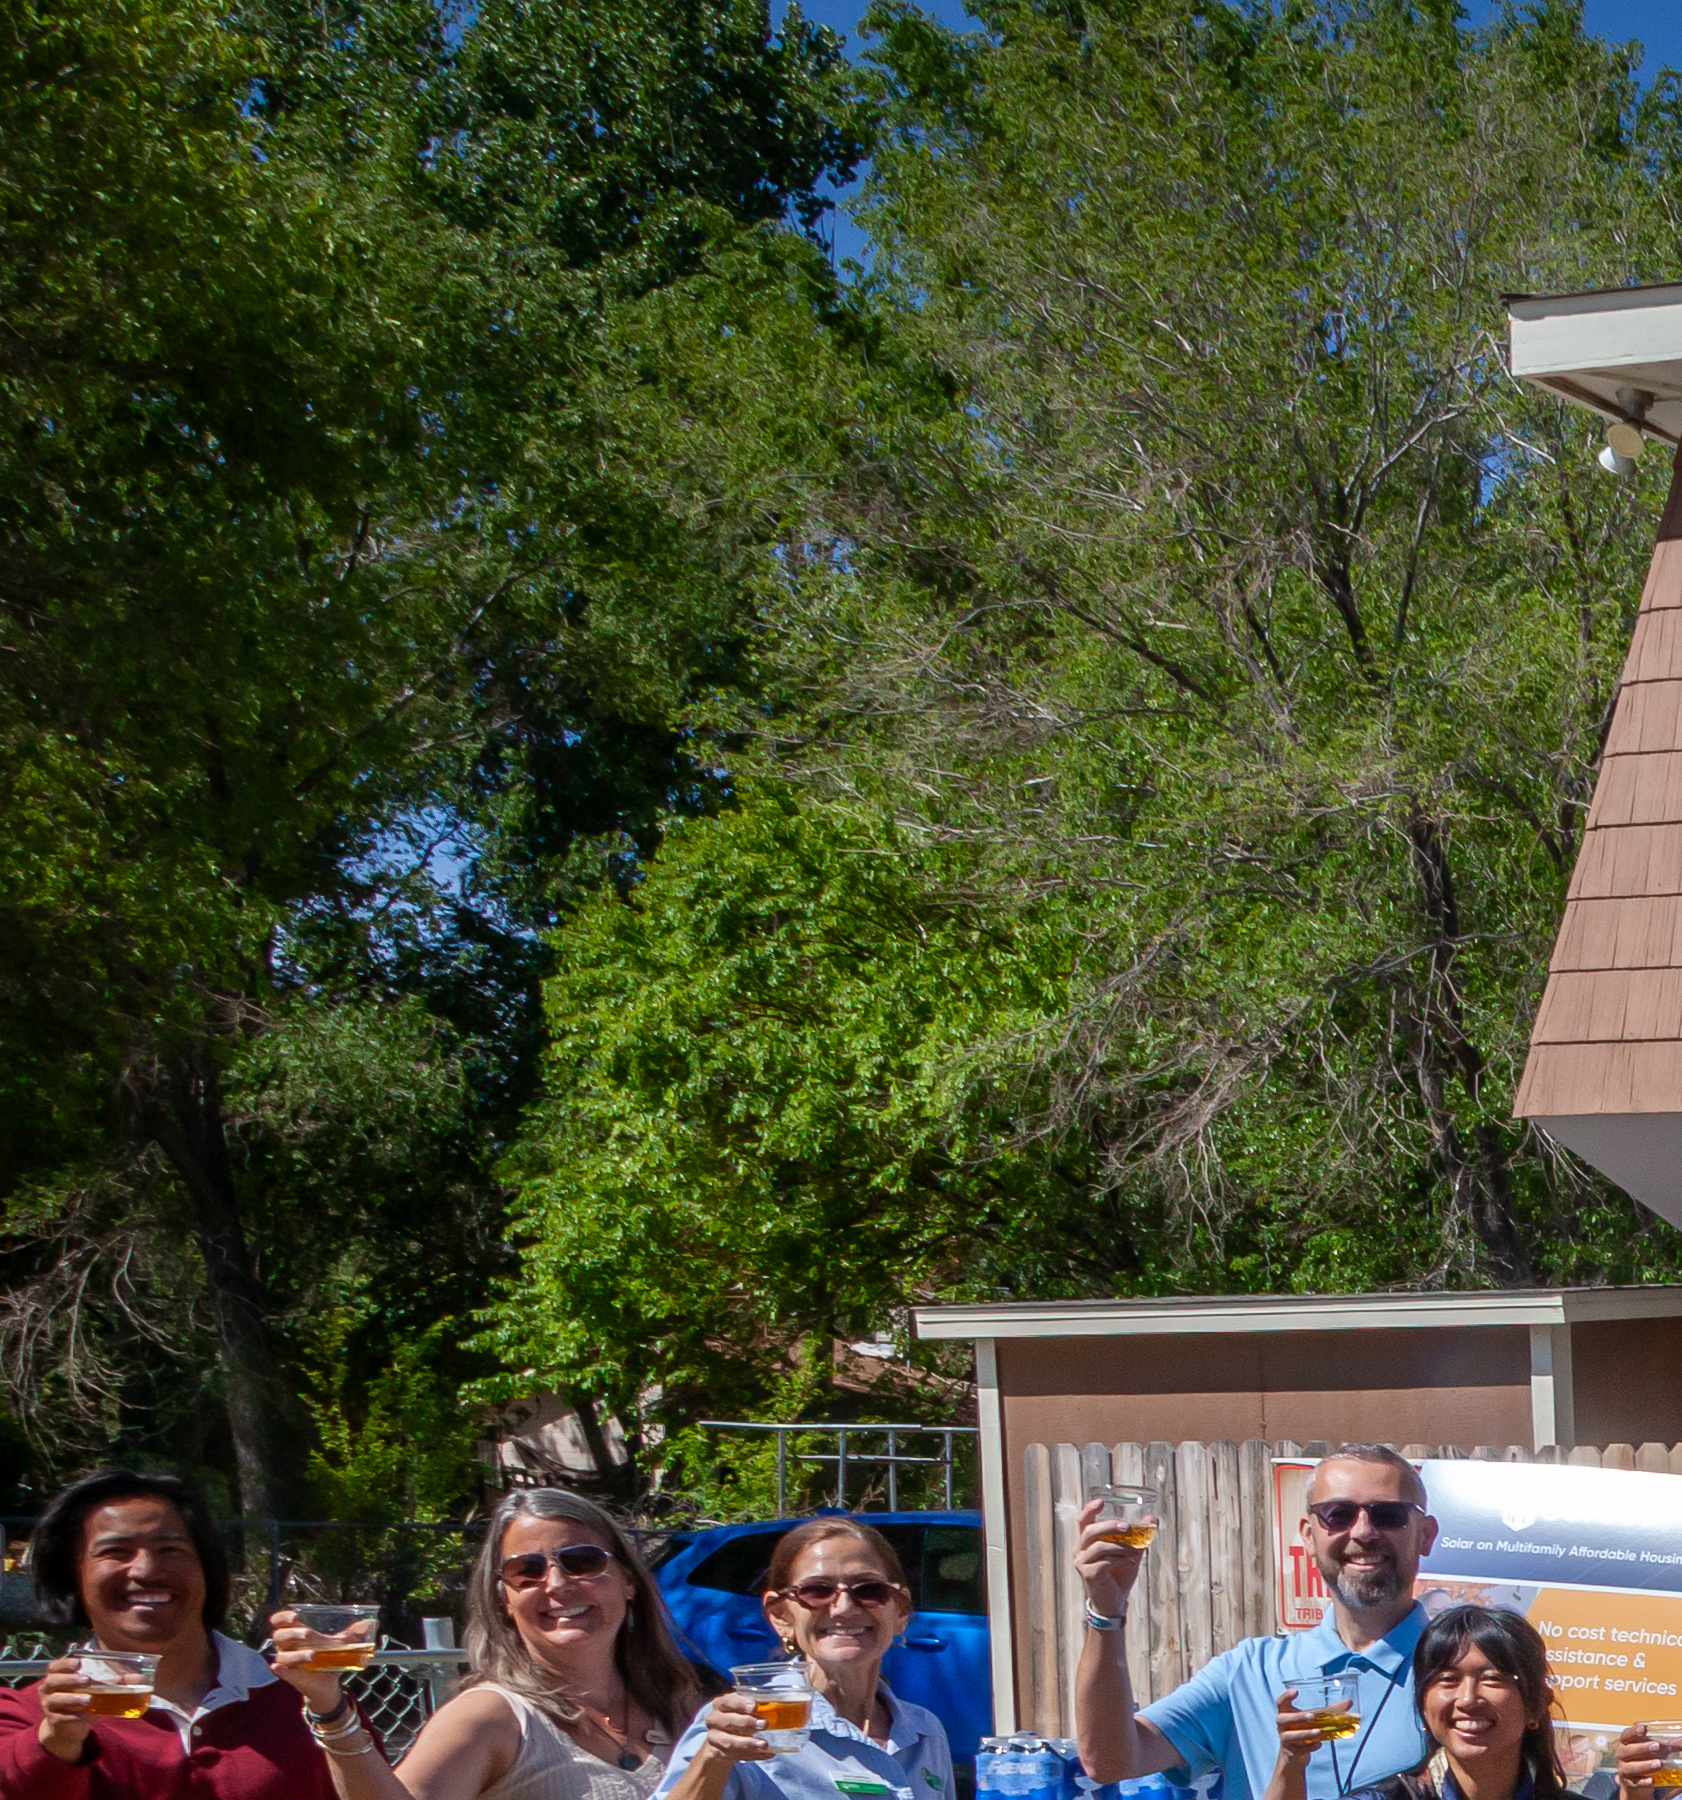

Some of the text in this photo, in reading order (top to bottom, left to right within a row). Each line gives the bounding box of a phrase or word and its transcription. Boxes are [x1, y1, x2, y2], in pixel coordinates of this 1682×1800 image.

[1441, 1536, 1474, 1549] Solar
[1476, 1540, 1493, 1551] on
[1496, 1540, 1566, 1558] Multifamily
[1569, 1545, 1637, 1561] Affordable
[1295, 1607, 1323, 1620] TRIB
[1538, 1620, 1563, 1638] No
[1567, 1625, 1606, 1640] cost
[1545, 1646, 1646, 1668] ssistance &
[1604, 1677, 1677, 1696] services
